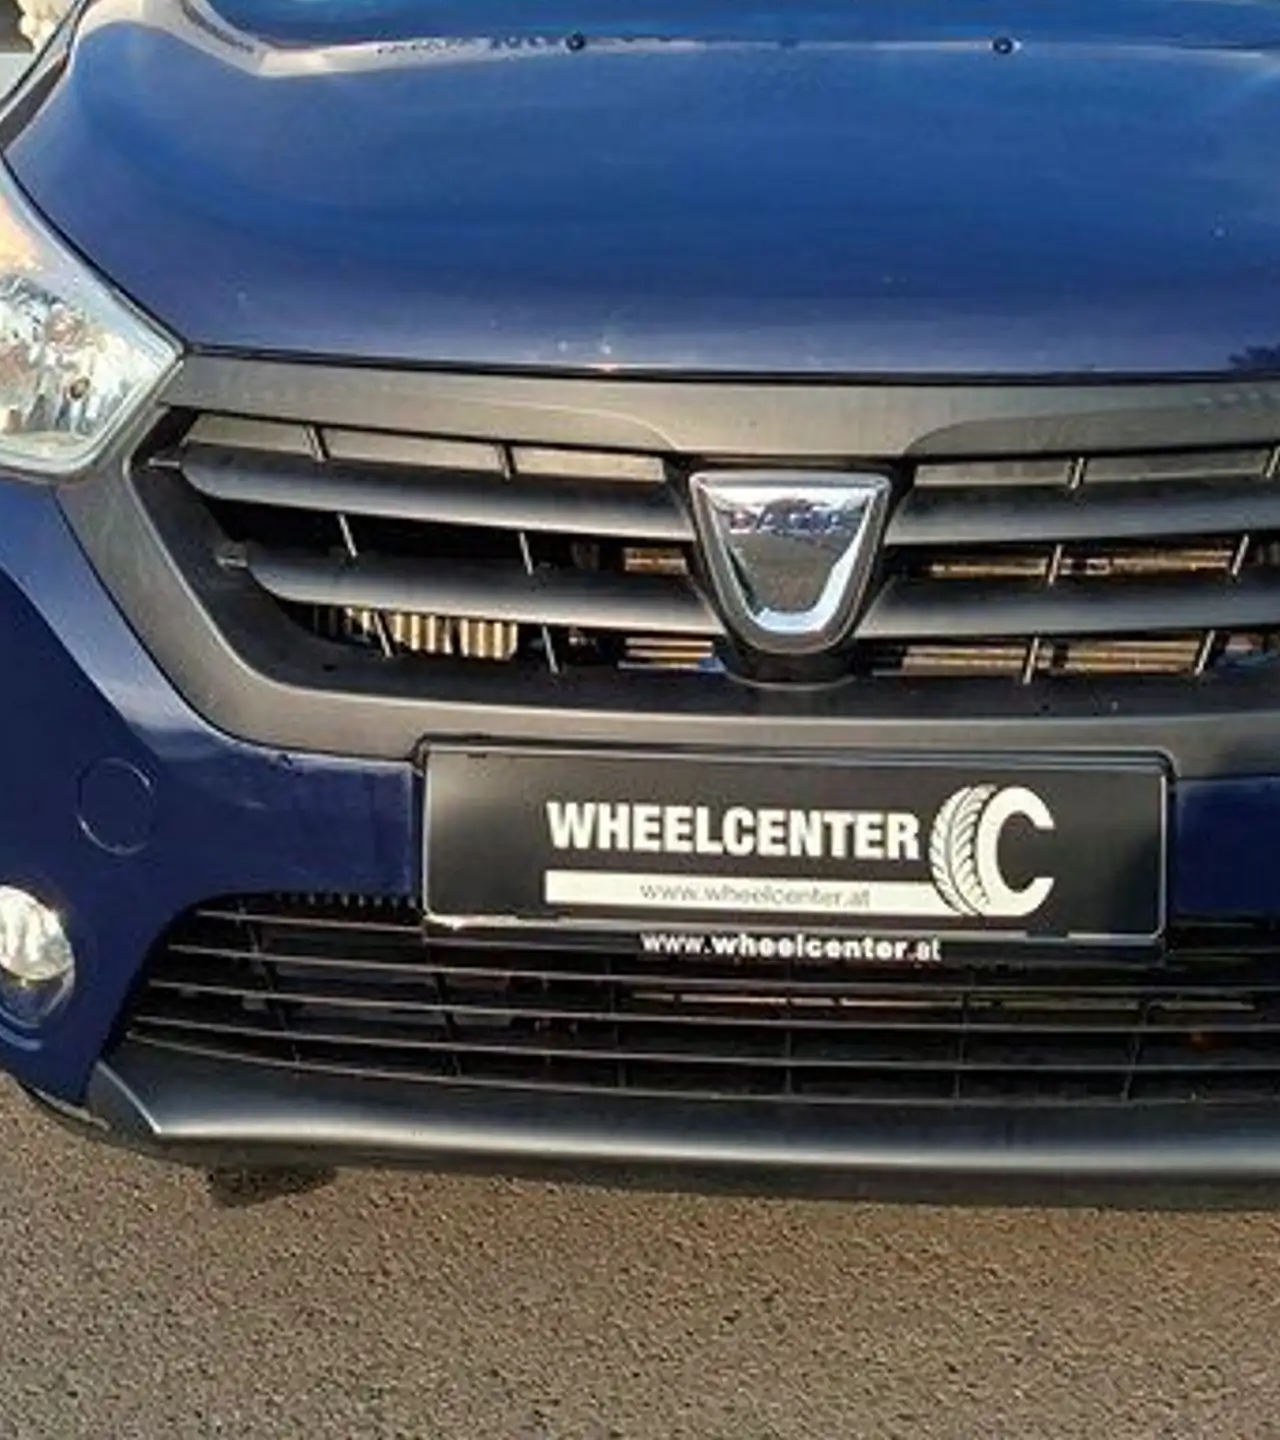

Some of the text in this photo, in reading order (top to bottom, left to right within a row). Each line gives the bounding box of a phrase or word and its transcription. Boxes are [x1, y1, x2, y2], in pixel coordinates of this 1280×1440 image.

[546, 801, 920, 860] WHEELCENTER
[640, 883, 871, 909] www.wheelcenter.at
[640, 932, 942, 962] www.wheelcenter.at
